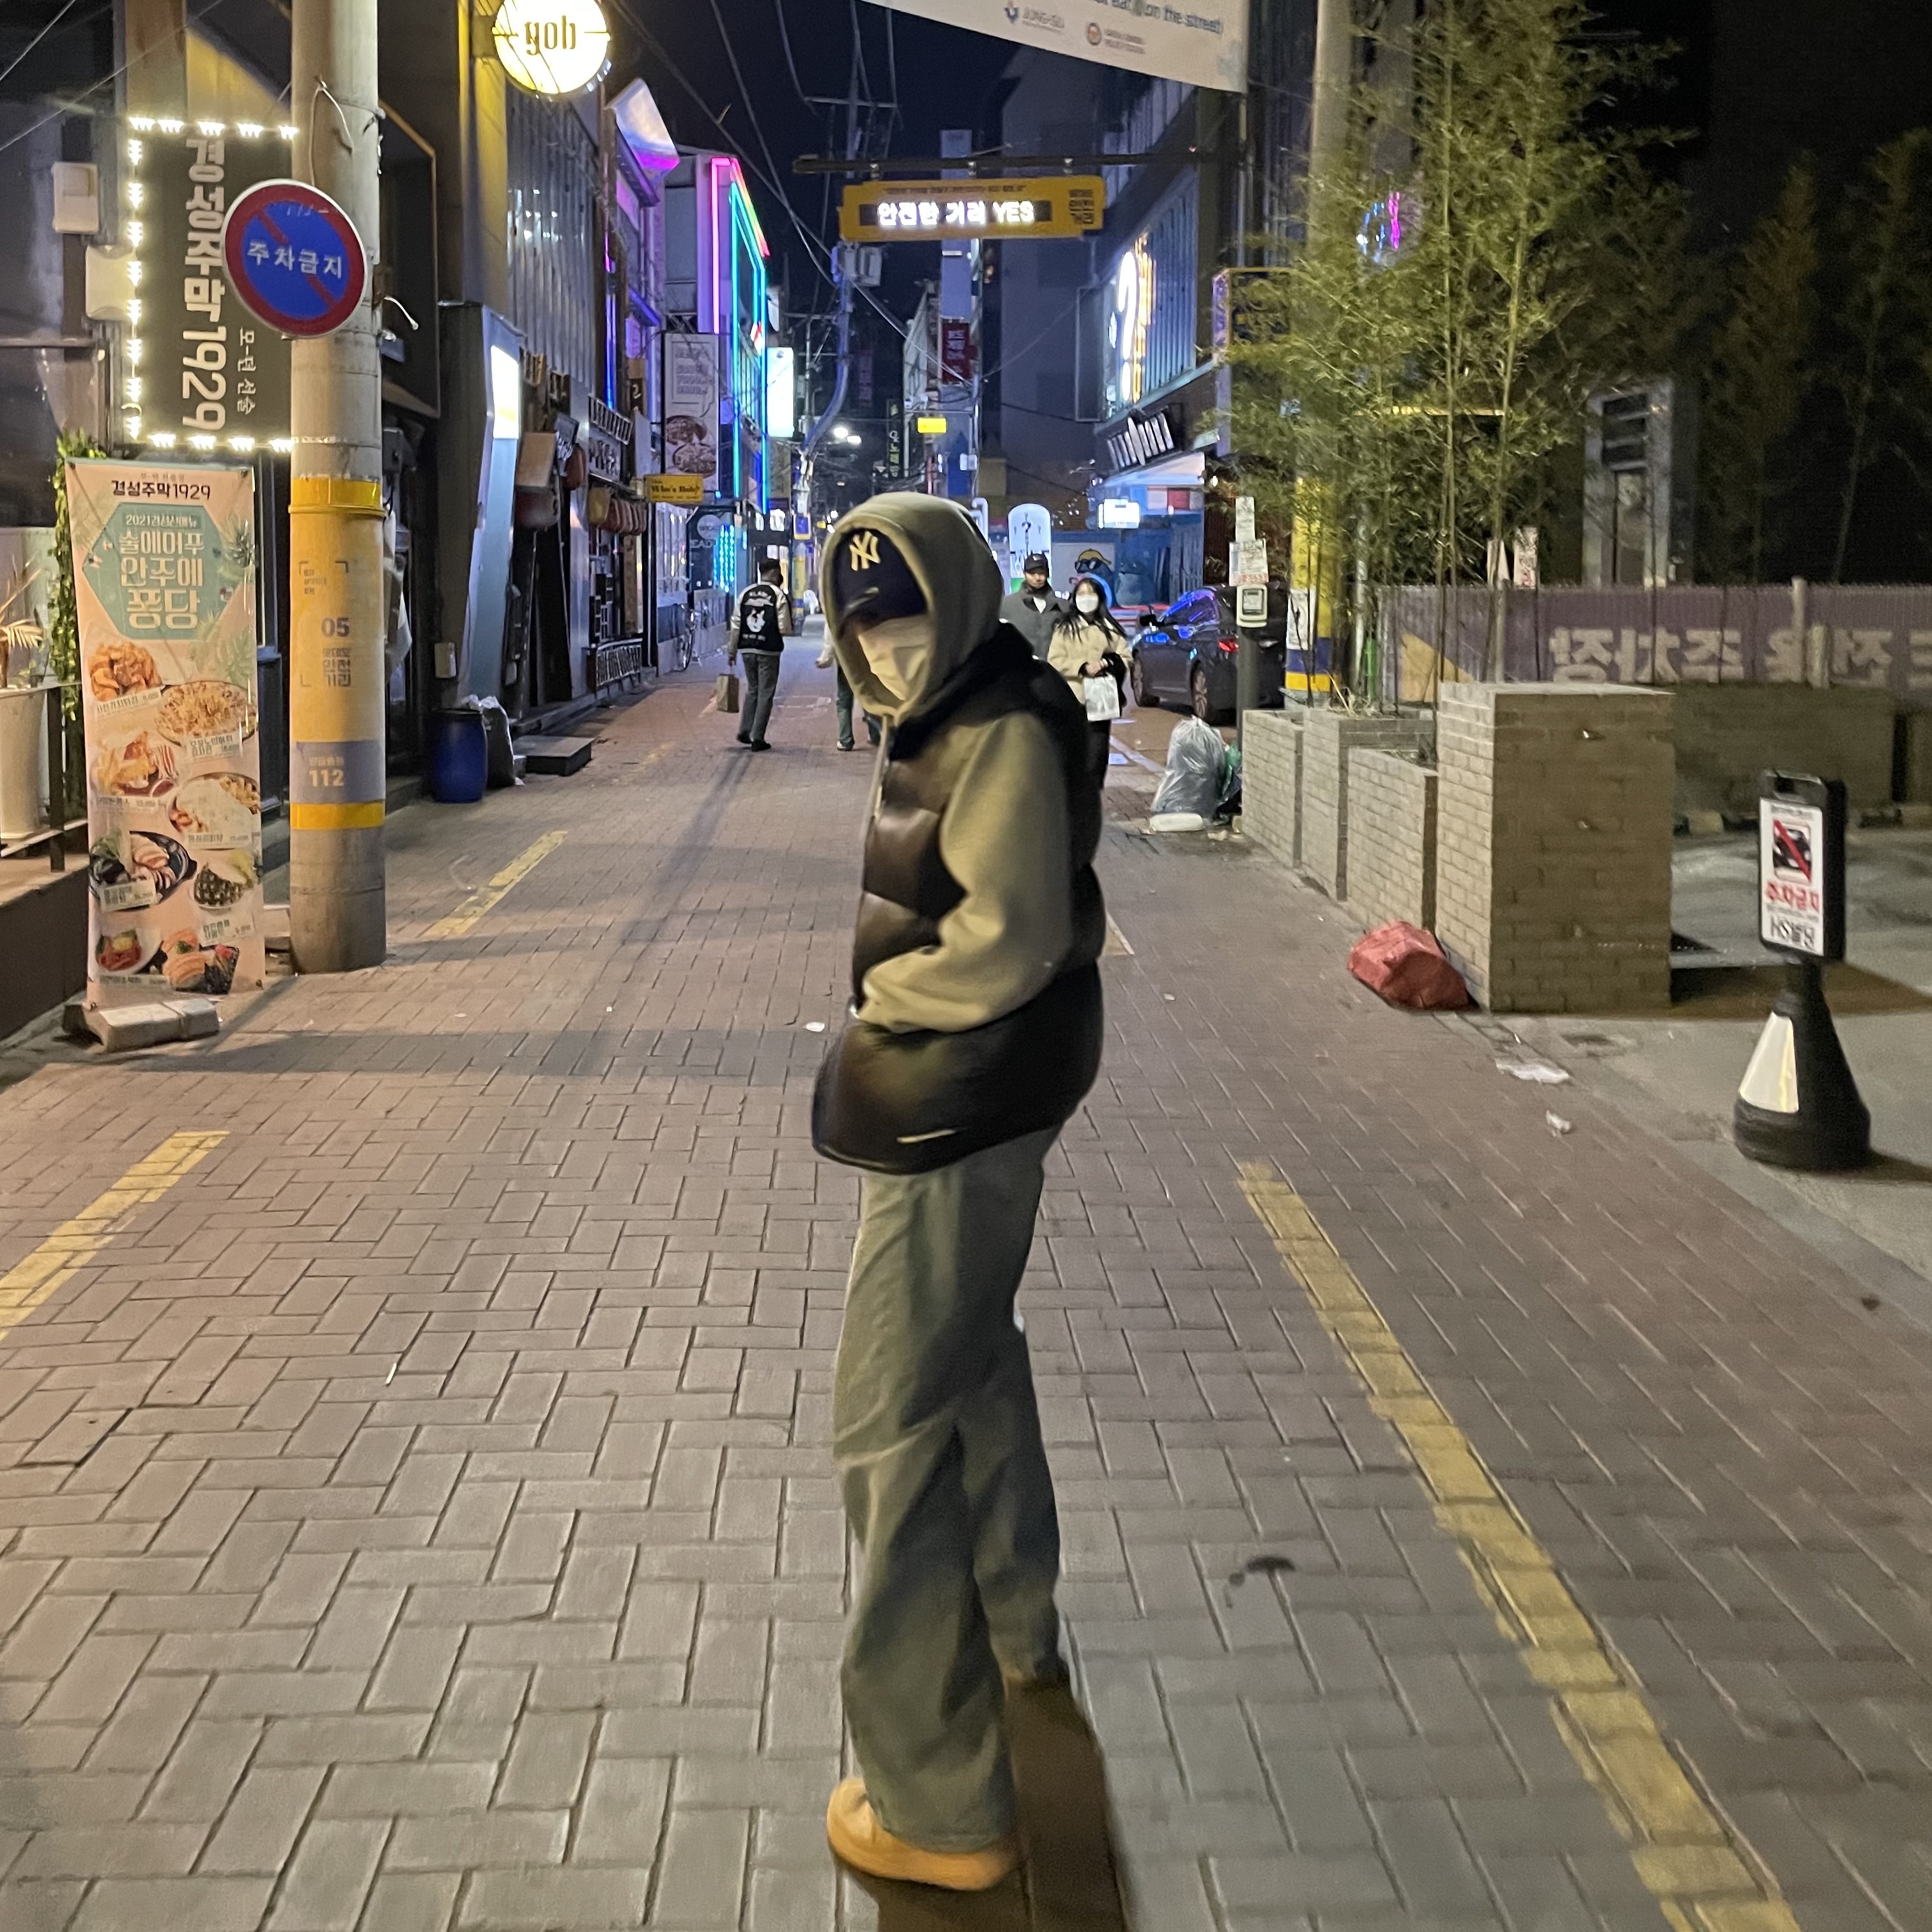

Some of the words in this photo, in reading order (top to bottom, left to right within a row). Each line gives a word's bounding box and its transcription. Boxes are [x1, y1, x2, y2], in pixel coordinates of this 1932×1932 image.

[945, 201, 986, 224] 거리
[992, 201, 1034, 223] YES
[247, 238, 342, 279] 주차금지
[111, 480, 211, 500] 경성주막1929
[849, 531, 881, 571] NY
[120, 556, 204, 587] 안주에
[127, 588, 201, 629] 퐁당
[321, 617, 350, 637] 05
[309, 769, 344, 787] 112
